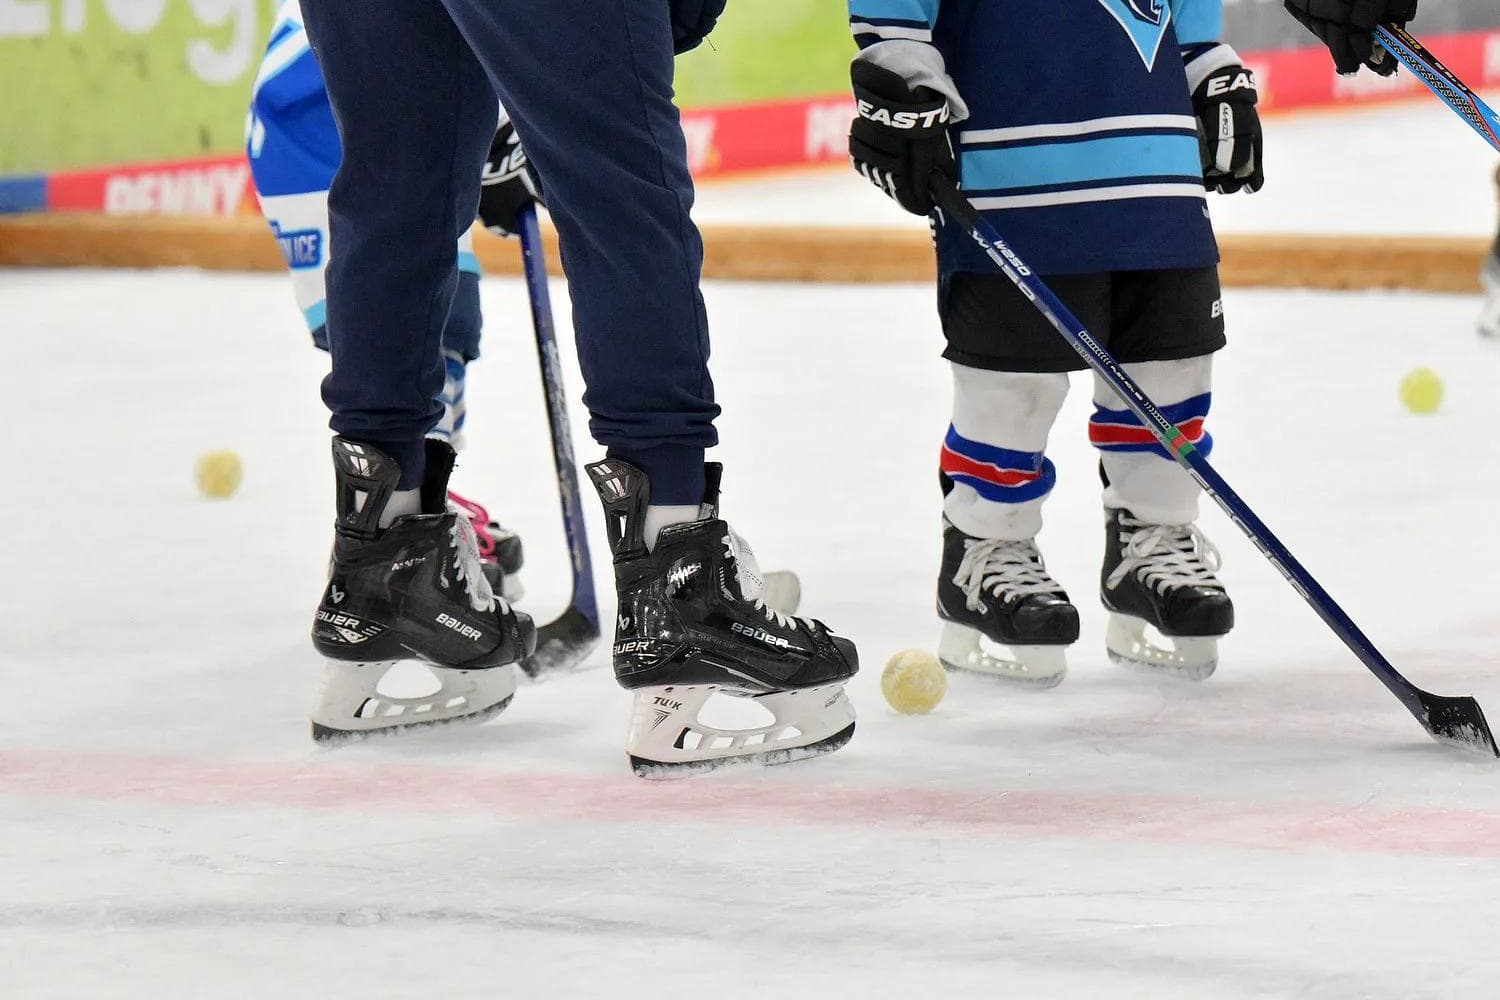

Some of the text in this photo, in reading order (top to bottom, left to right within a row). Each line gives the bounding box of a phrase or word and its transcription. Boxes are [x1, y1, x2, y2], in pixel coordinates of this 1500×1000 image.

[992, 237, 1032, 279] W250
[435, 612, 482, 641] BAUER
[731, 621, 790, 650] BAUER
